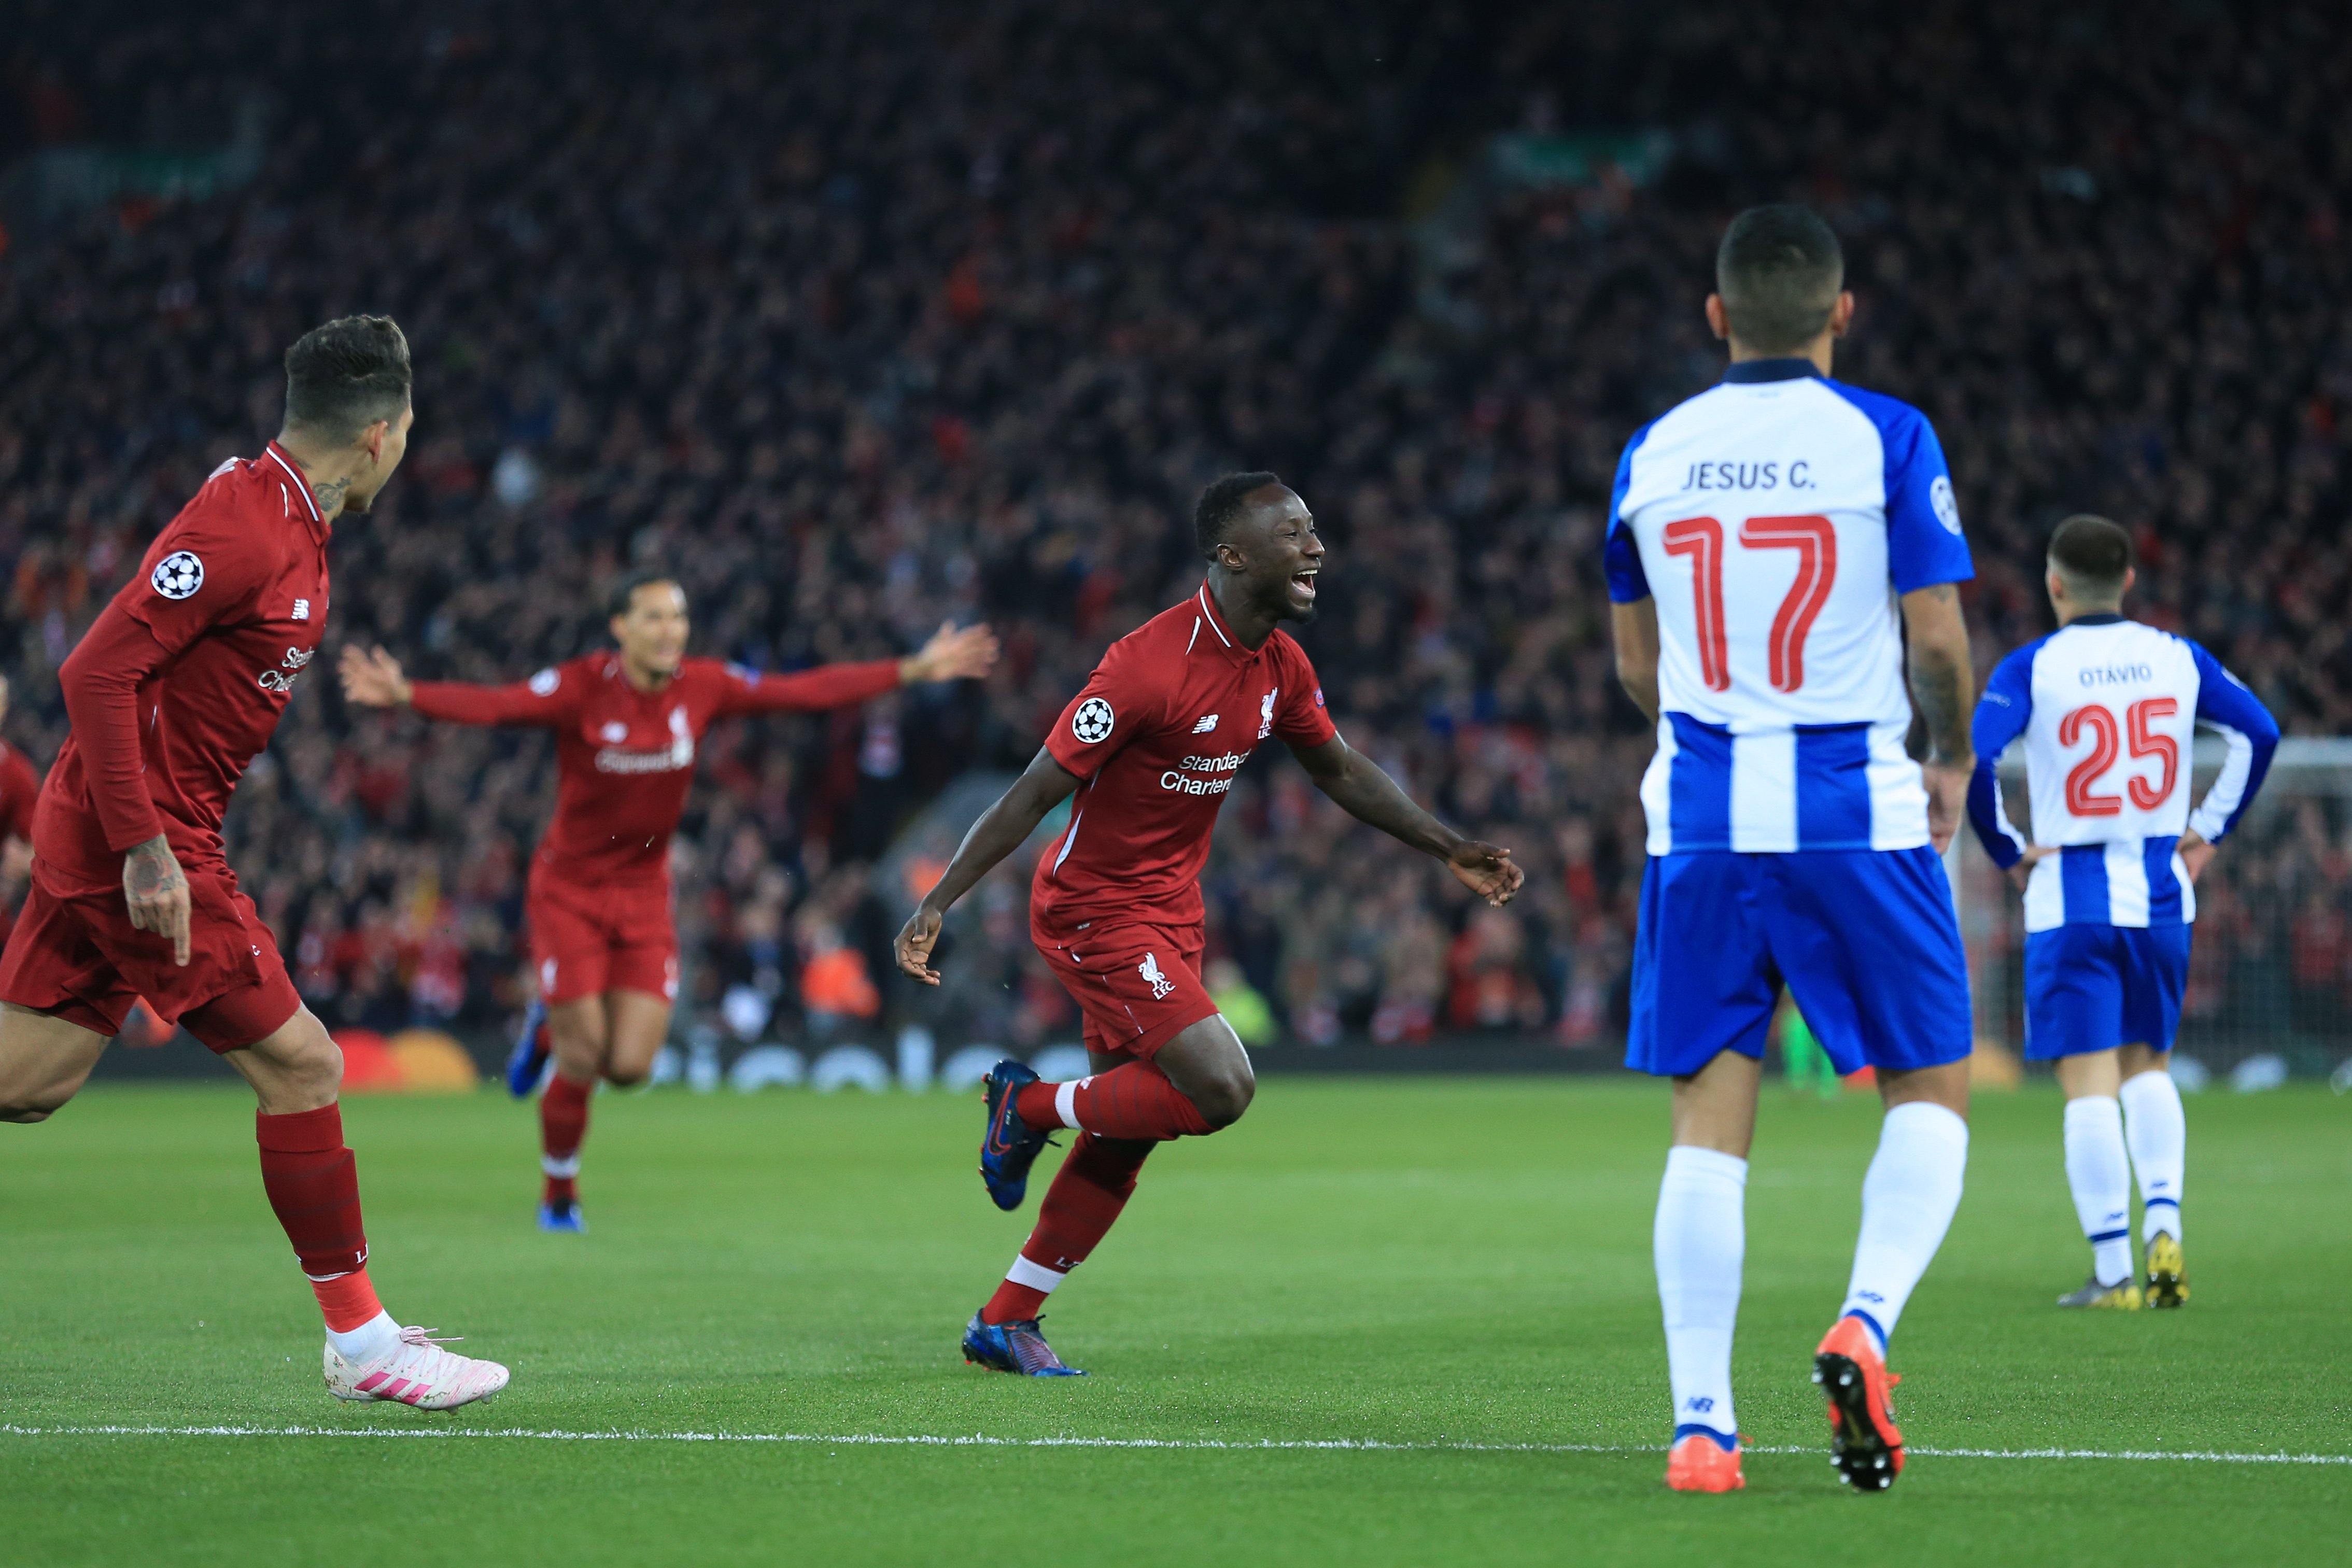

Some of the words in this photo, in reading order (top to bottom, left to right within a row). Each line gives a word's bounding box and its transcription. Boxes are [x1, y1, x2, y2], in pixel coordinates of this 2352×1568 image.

[1682, 461, 1778, 490] JESUS
[1790, 460, 1816, 488] C.
[1662, 514, 1837, 694] 17
[2059, 697, 2178, 817] 25
[1153, 981, 1177, 1000] LFC
